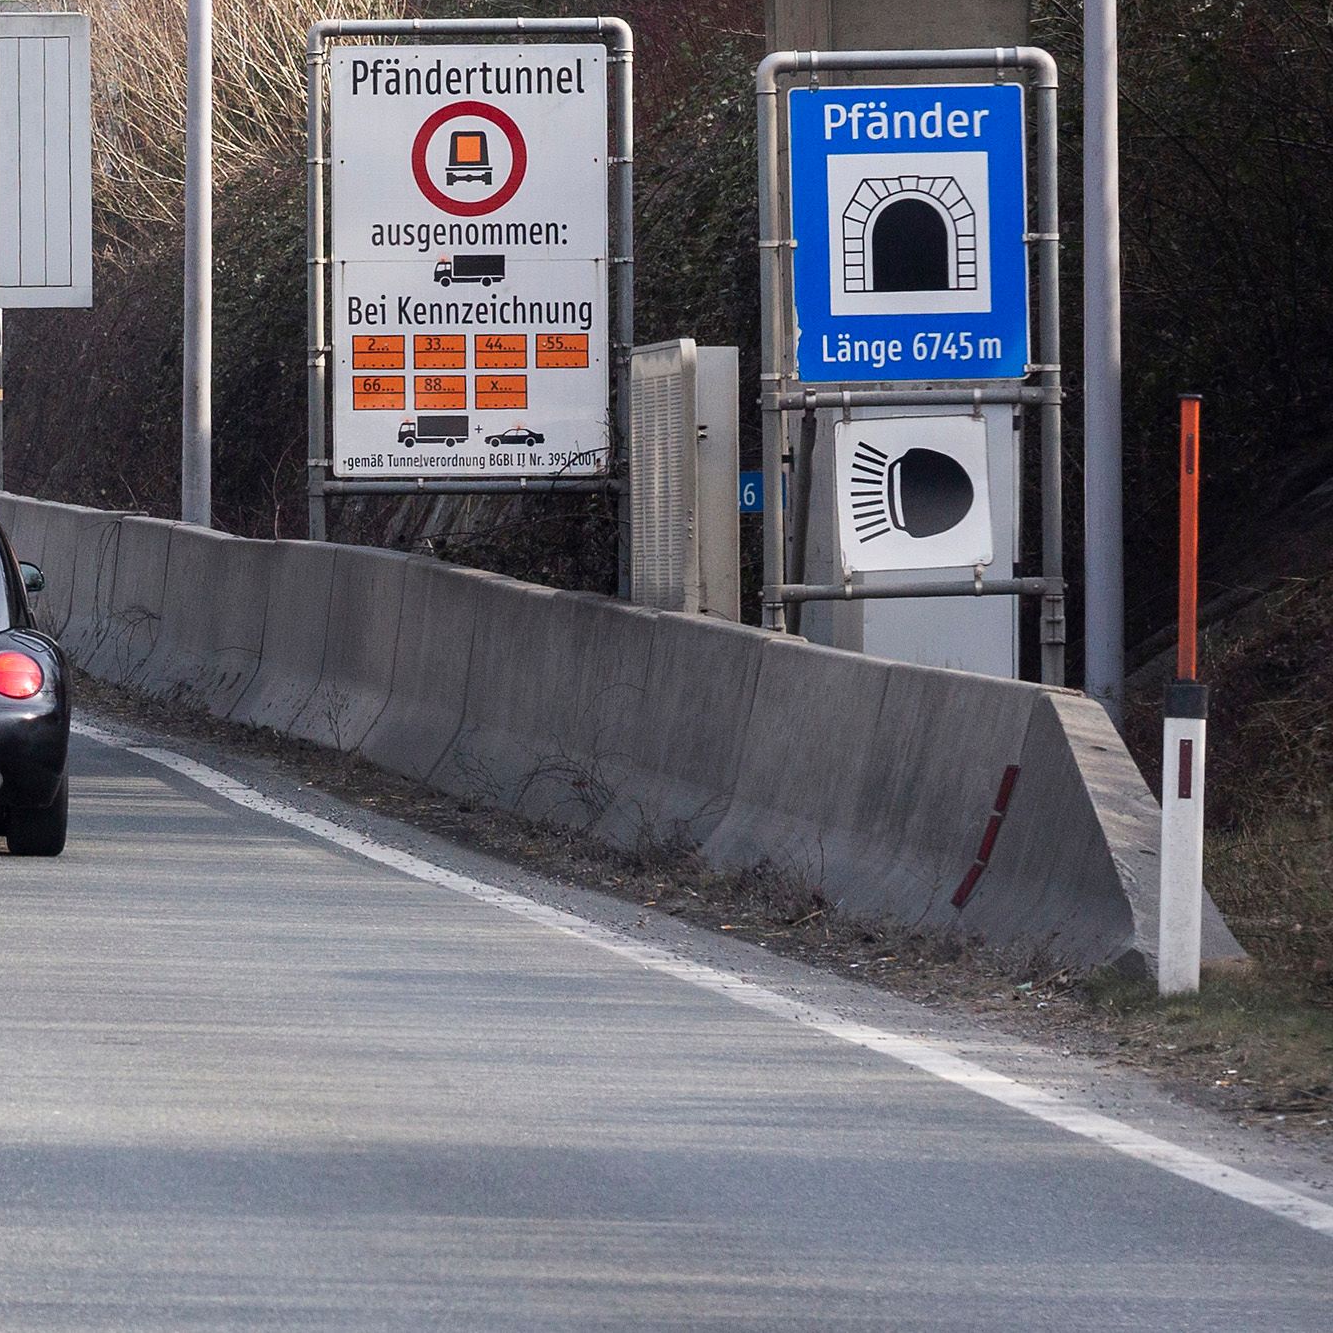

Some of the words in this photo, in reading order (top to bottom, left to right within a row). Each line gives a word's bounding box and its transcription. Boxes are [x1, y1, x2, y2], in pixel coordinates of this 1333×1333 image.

[352, 58, 585, 95] Pfändertunnel
[824, 102, 989, 140] Pfänder
[371, 222, 568, 252] ausgenommen:
[348, 294, 386, 325] Bei
[398, 294, 592, 330] Kennzeichnung
[822, 333, 903, 368] Länge
[912, 332, 974, 361] 6745
[978, 337, 1002, 359] m
[347, 454, 384, 470] gemäß
[387, 453, 486, 469] Tunnelverordnung
[529, 453, 545, 466] Nr.
[548, 451, 597, 467] 395/2001
